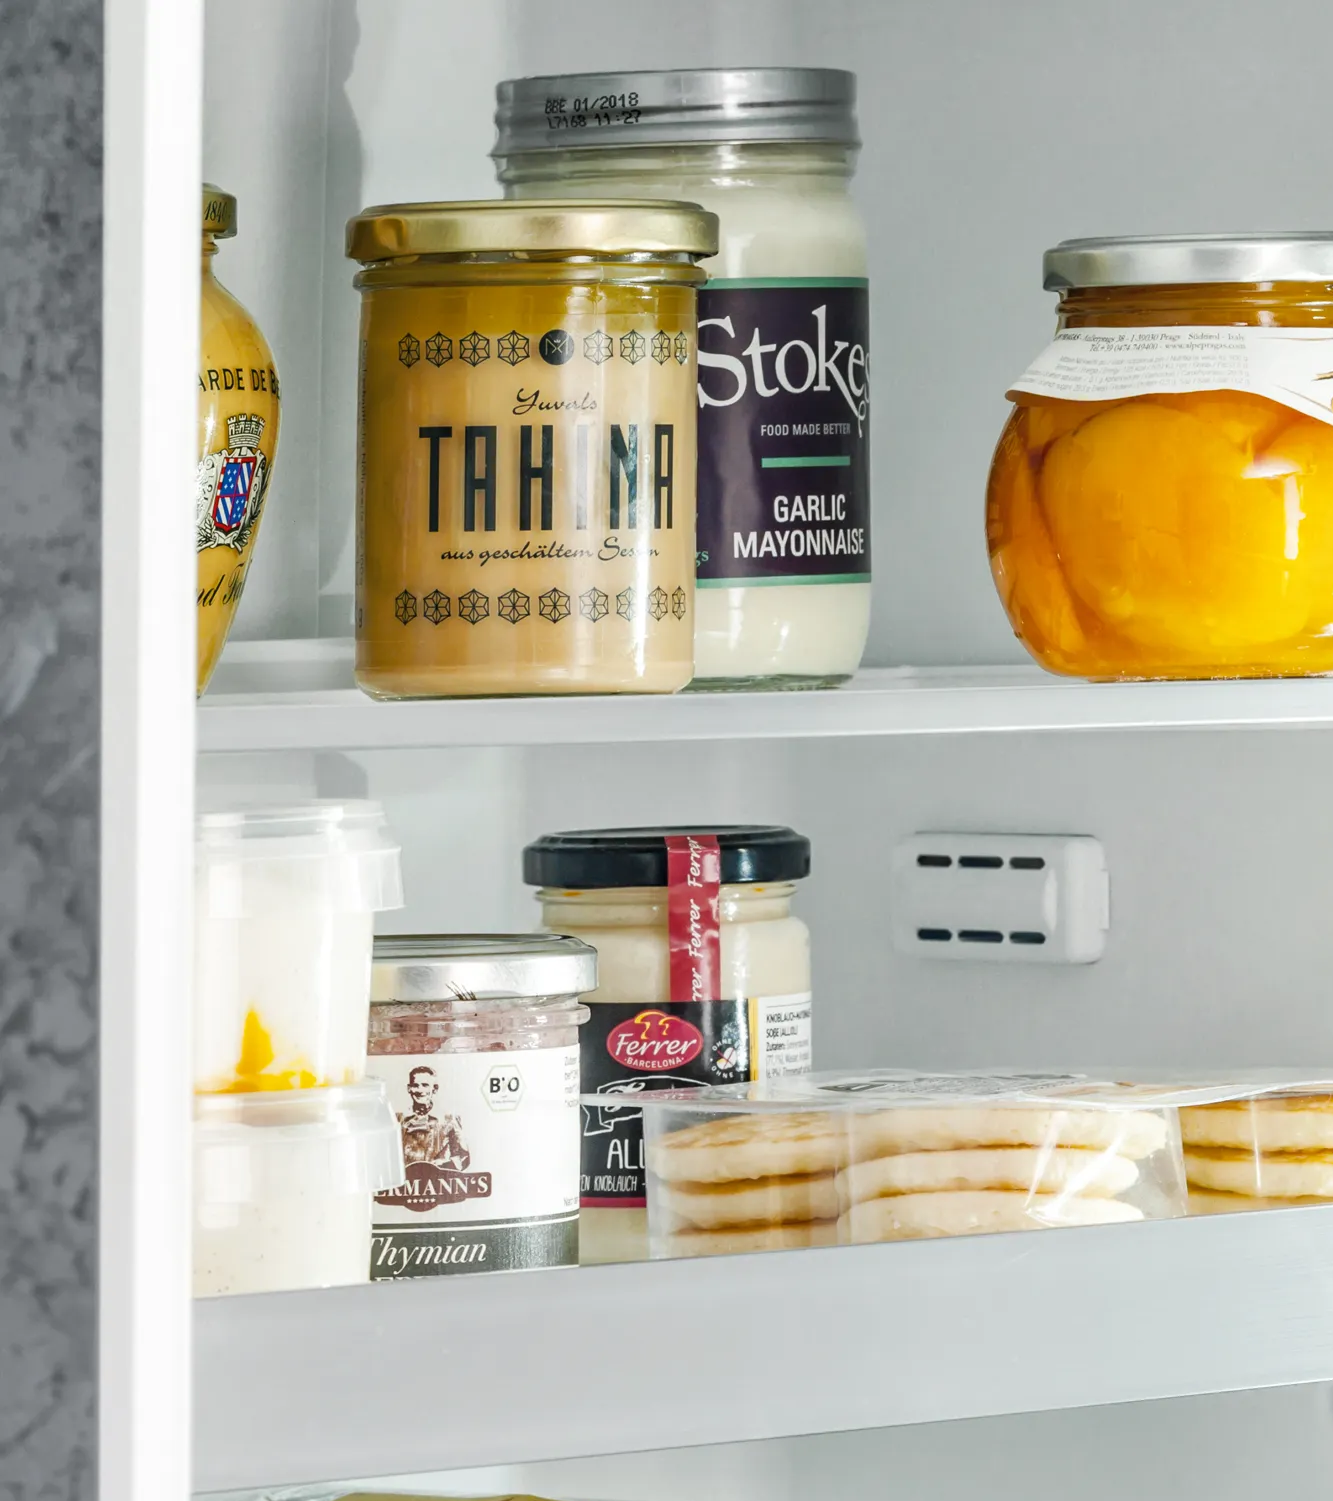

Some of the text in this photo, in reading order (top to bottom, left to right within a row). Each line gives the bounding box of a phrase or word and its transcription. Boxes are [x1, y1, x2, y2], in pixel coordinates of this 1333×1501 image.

[545, 92, 639, 114] BBE 01/2018
[251, 368, 267, 392] DE
[512, 388, 598, 415] Yuvals
[760, 422, 851, 437] FOOD MADE BETTER
[418, 423, 674, 533] TAHINA
[773, 493, 846, 523] GARLIC
[441, 547, 474, 560] aus
[478, 541, 594, 567] geschältem
[733, 527, 864, 559] MAYONNAISE
[688, 898, 704, 958] Ferrer
[614, 1032, 698, 1057] Ferrer
[625, 1057, 684, 1069] BARCELONA
[711, 1065, 734, 1079] OHNE
[593, 1175, 638, 1192] KNOBLAUCH
[371, 1236, 487, 1275] Thymian
